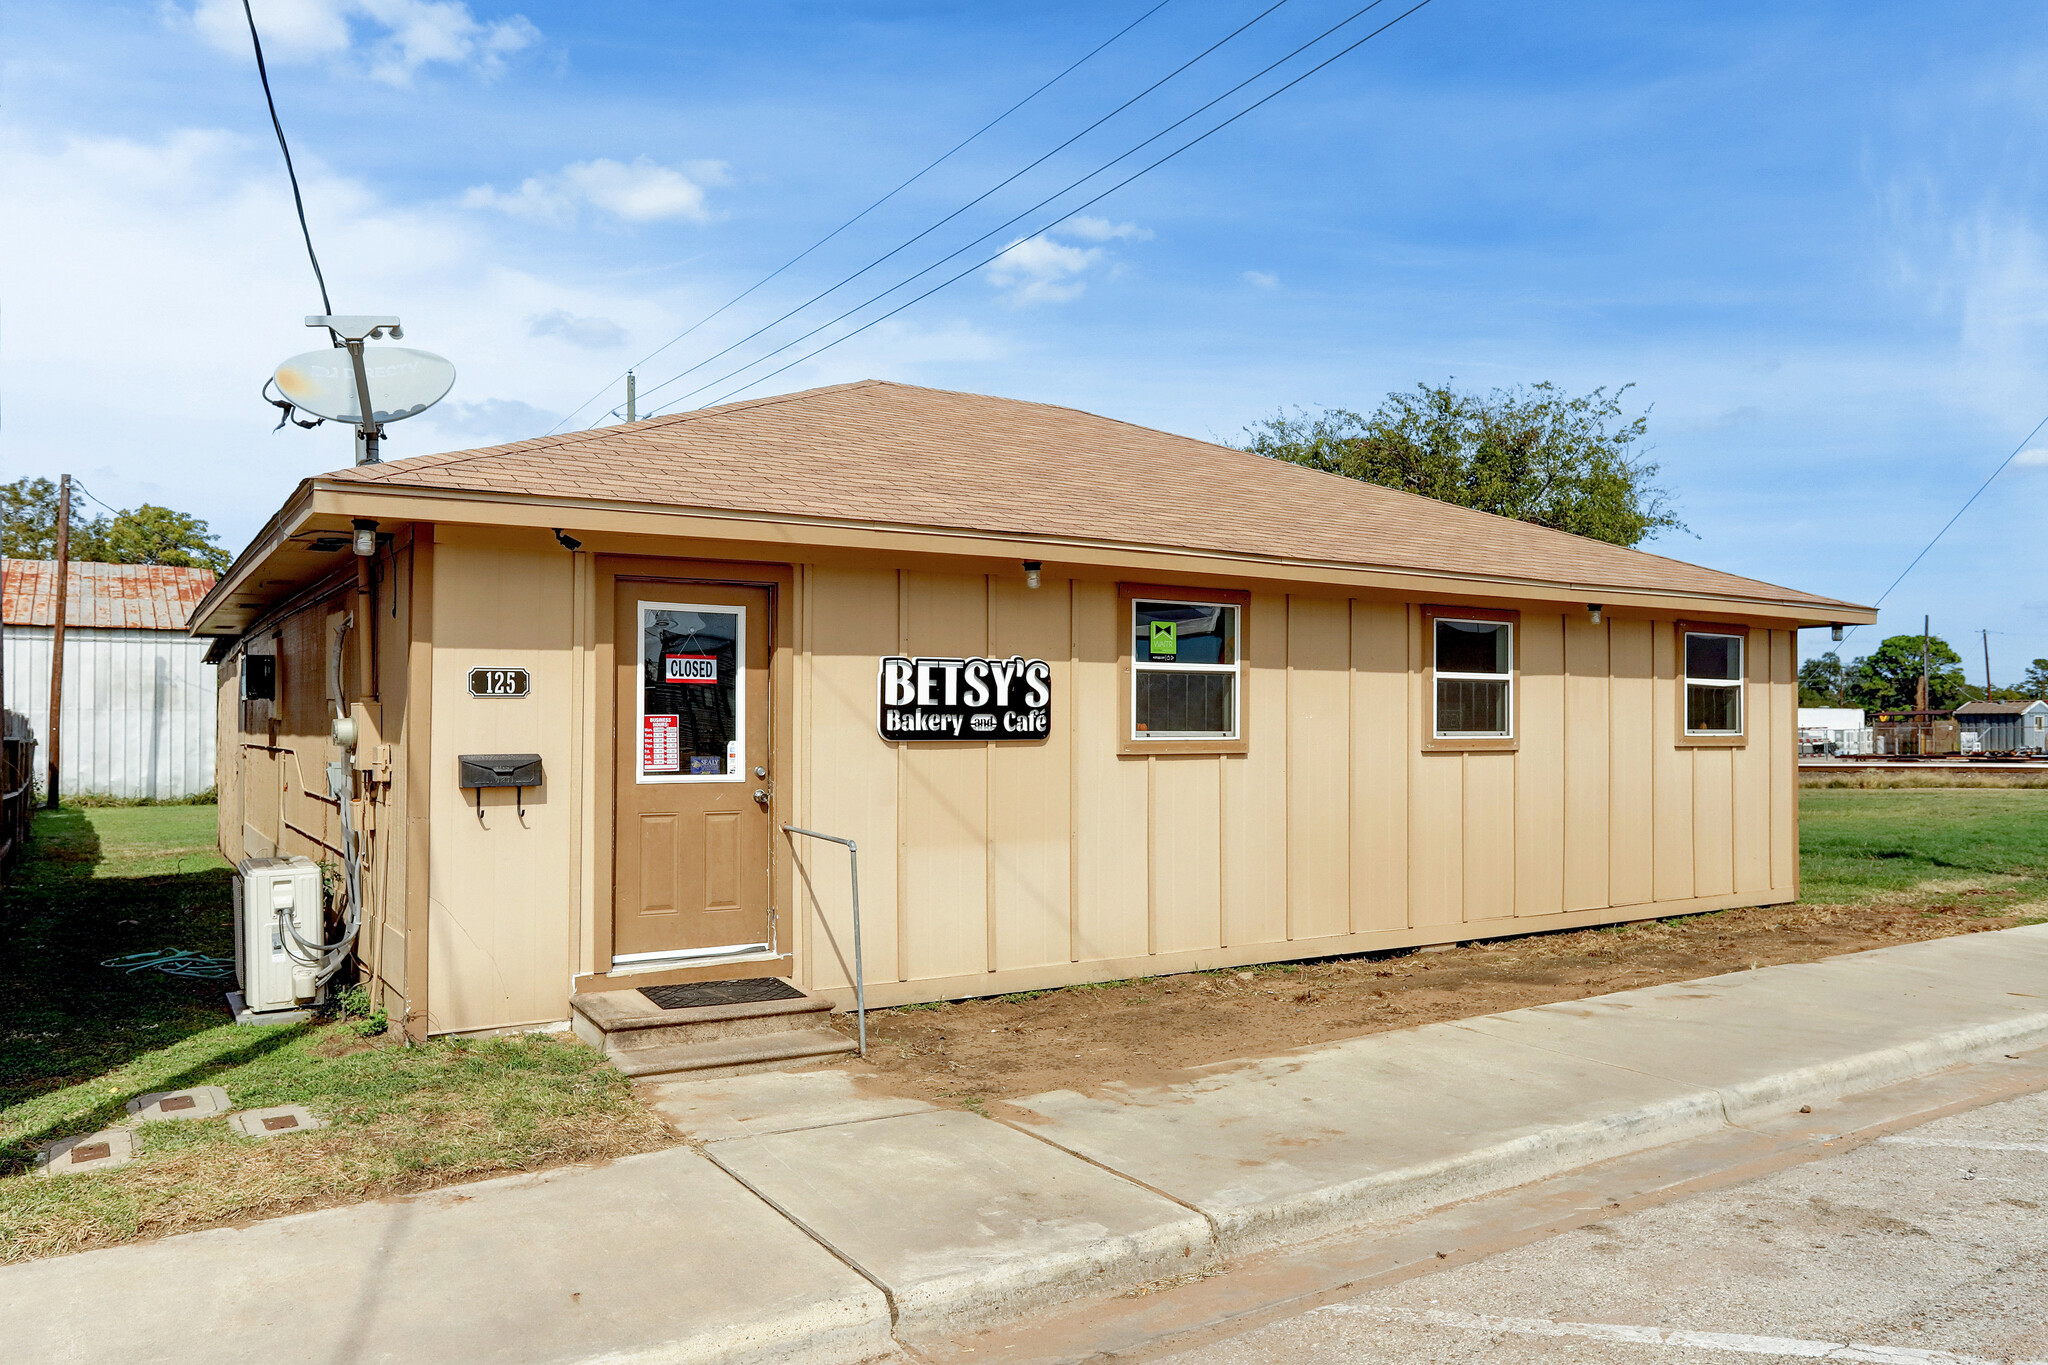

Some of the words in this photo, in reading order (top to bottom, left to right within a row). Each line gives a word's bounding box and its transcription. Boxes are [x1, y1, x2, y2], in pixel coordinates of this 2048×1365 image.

[671, 660, 713, 677] CLOSED
[486, 671, 516, 694] 125
[885, 659, 1050, 707] BETSY'S
[886, 709, 964, 736] Bakery
[1004, 709, 1048, 733] Café
